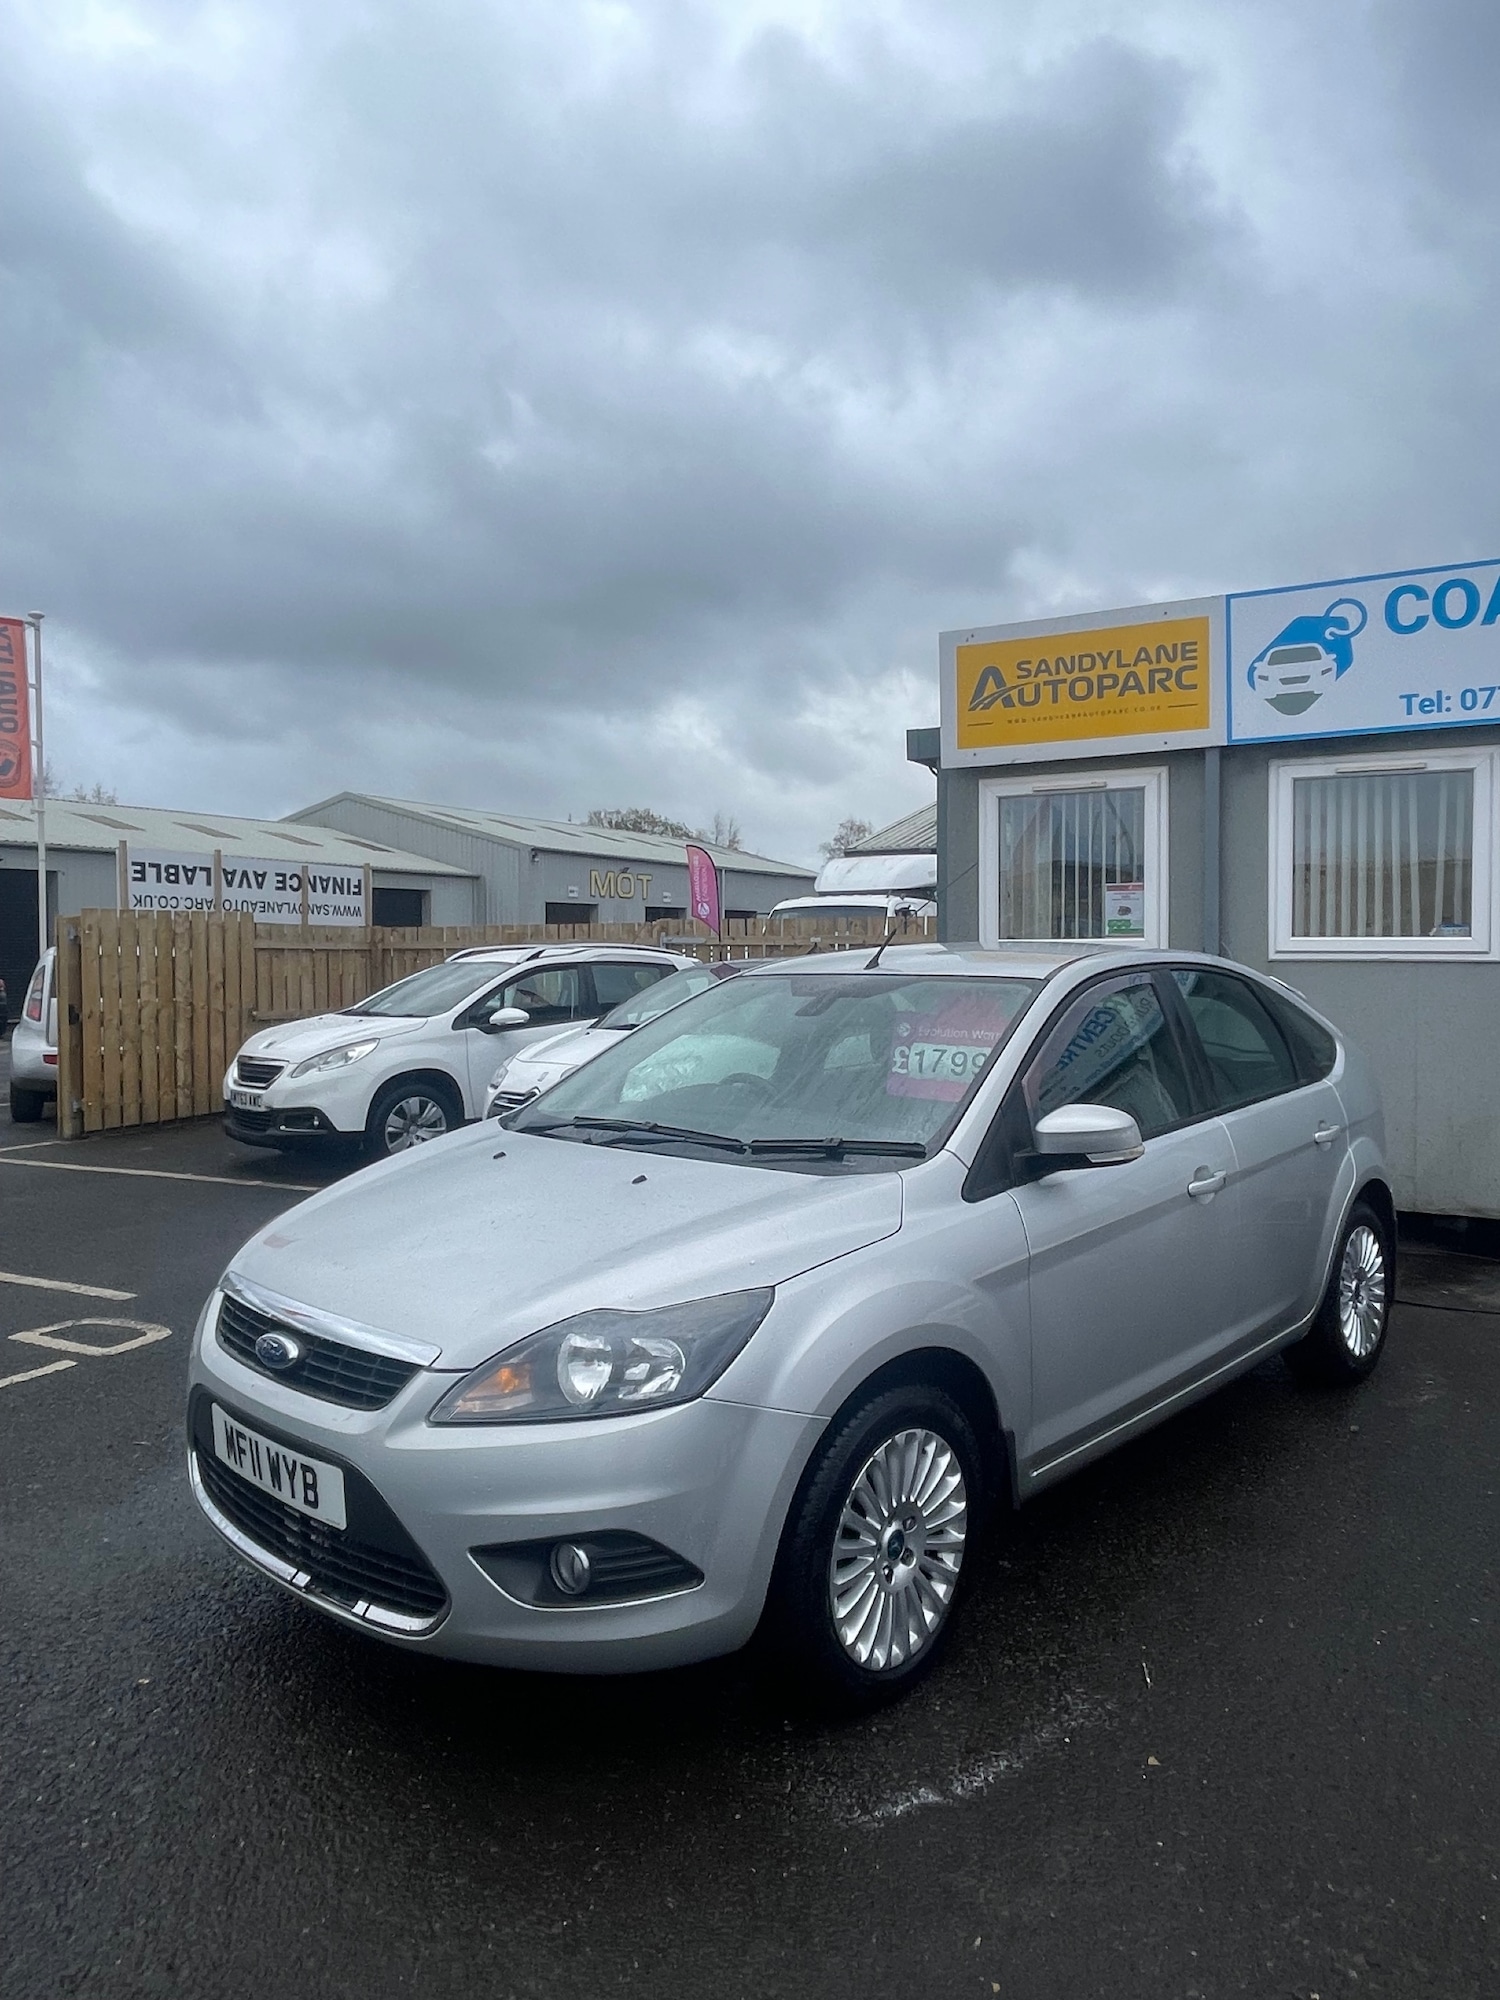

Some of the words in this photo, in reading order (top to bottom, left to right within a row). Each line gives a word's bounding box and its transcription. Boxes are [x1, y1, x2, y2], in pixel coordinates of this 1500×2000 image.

[1016, 641, 1198, 679] SANDYLANE
[968, 664, 1198, 712] AUTOPARC
[1399, 689, 1452, 716] Tel:
[1460, 685, 1500, 711] 07
[131, 861, 267, 889] AVALABLE
[275, 872, 362, 896] FINANCE
[590, 869, 653, 900] MOT
[133, 894, 362, 917] WWW.SANYLANEAUTOARC.CO.UK
[918, 1025, 968, 1039] Evolution
[892, 1046, 988, 1077] £1799
[266, 1446, 319, 1510] WYB
